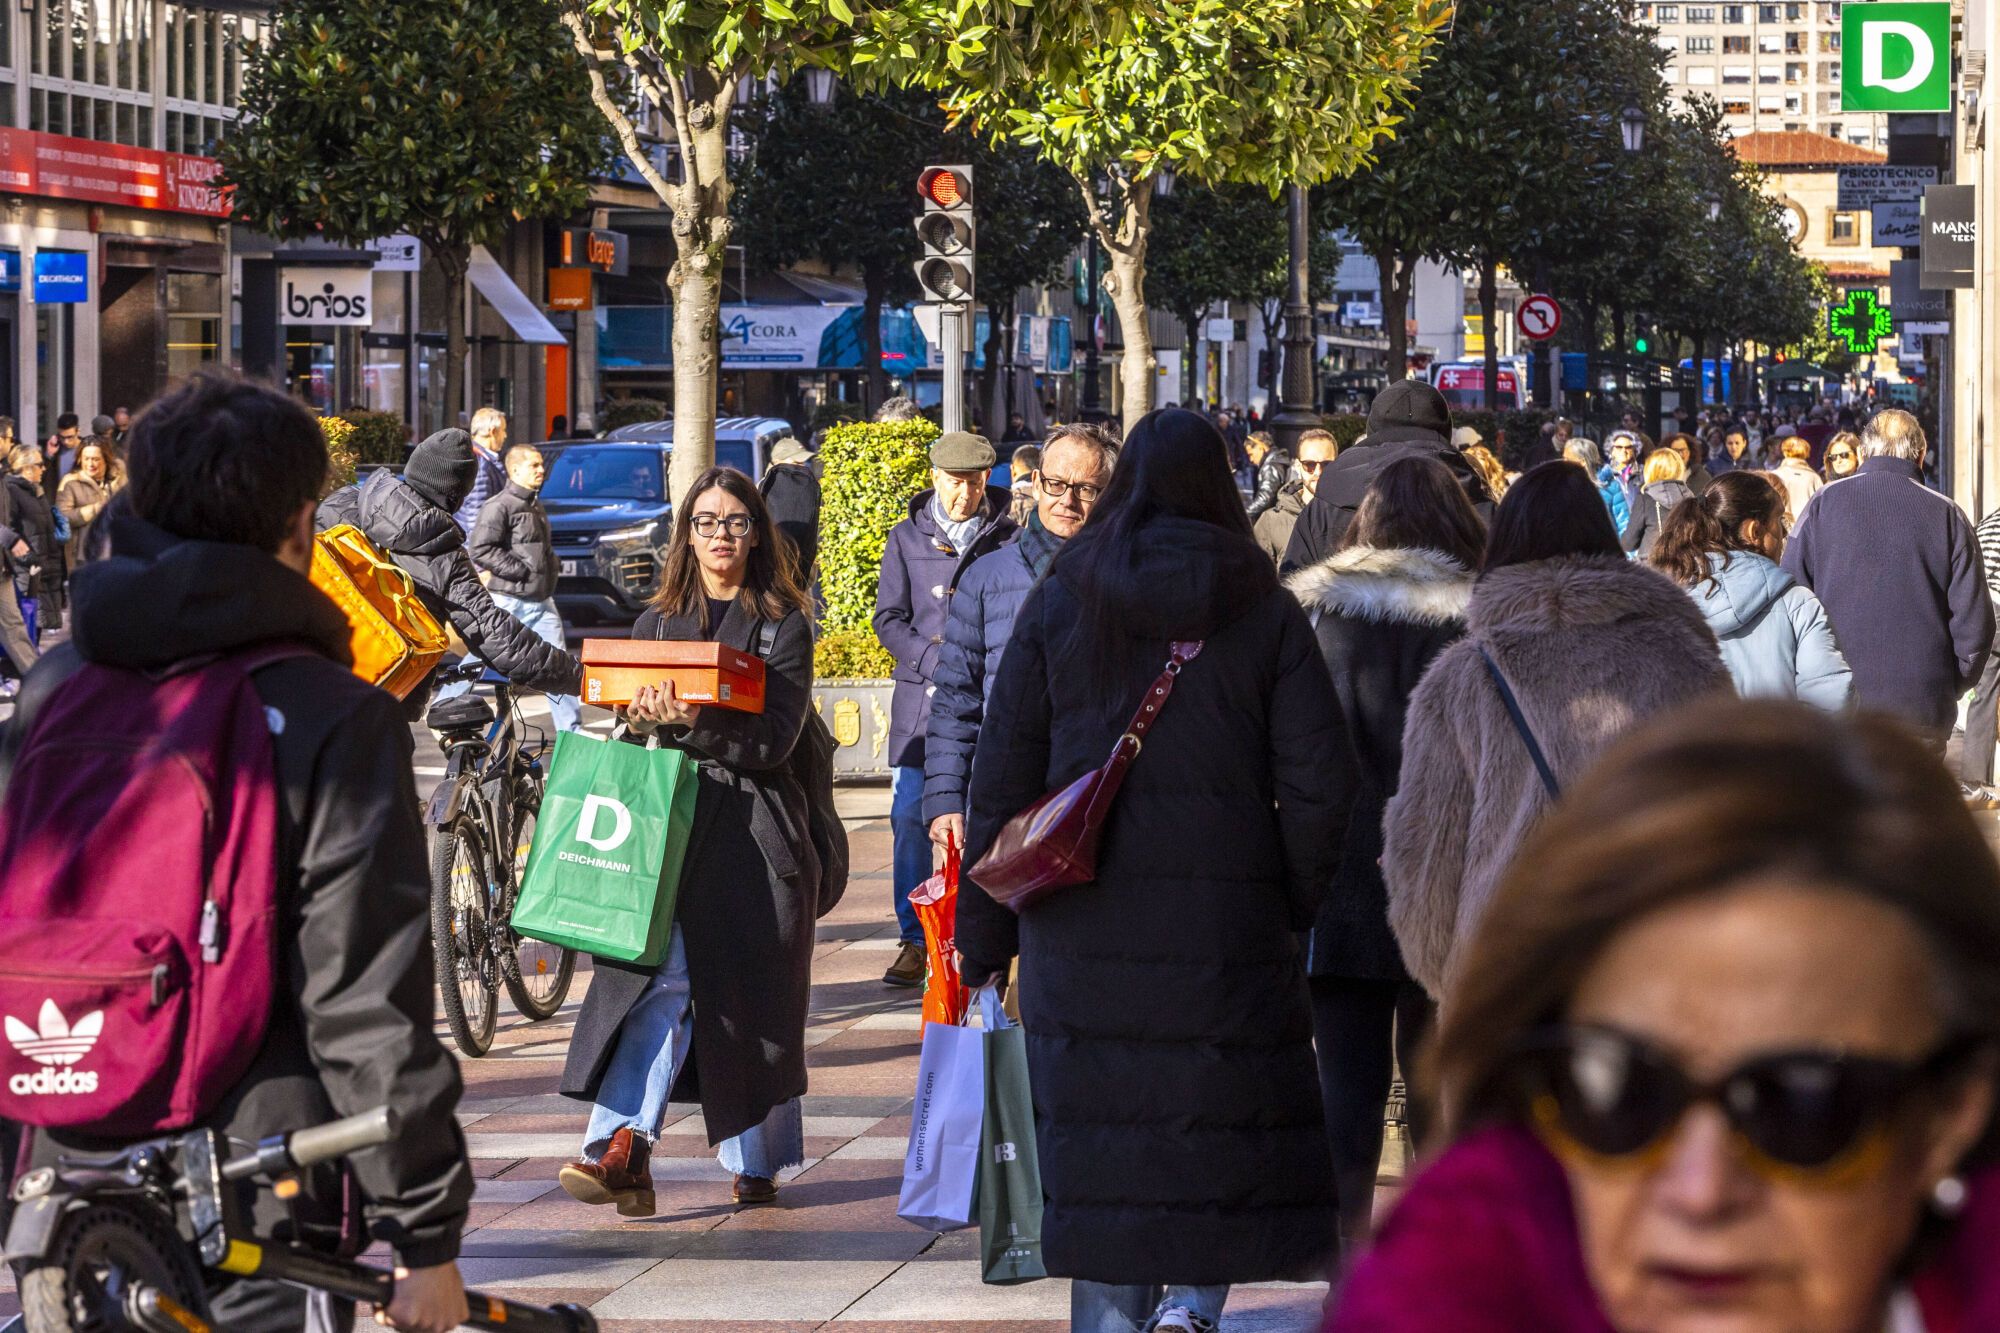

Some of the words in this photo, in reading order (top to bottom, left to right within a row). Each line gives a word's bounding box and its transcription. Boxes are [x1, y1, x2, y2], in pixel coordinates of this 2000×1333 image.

[1862, 21, 1934, 93] D
[1840, 168, 1935, 178] PSICOTECNICO
[287, 282, 366, 318] brios
[1895, 301, 1945, 310] MANGO
[575, 794, 632, 851] D
[558, 851, 631, 872] DEICHMANN
[9, 1066, 99, 1095] adidas
[915, 1071, 935, 1171] womensecret.com
[994, 1143, 1016, 1163] B
